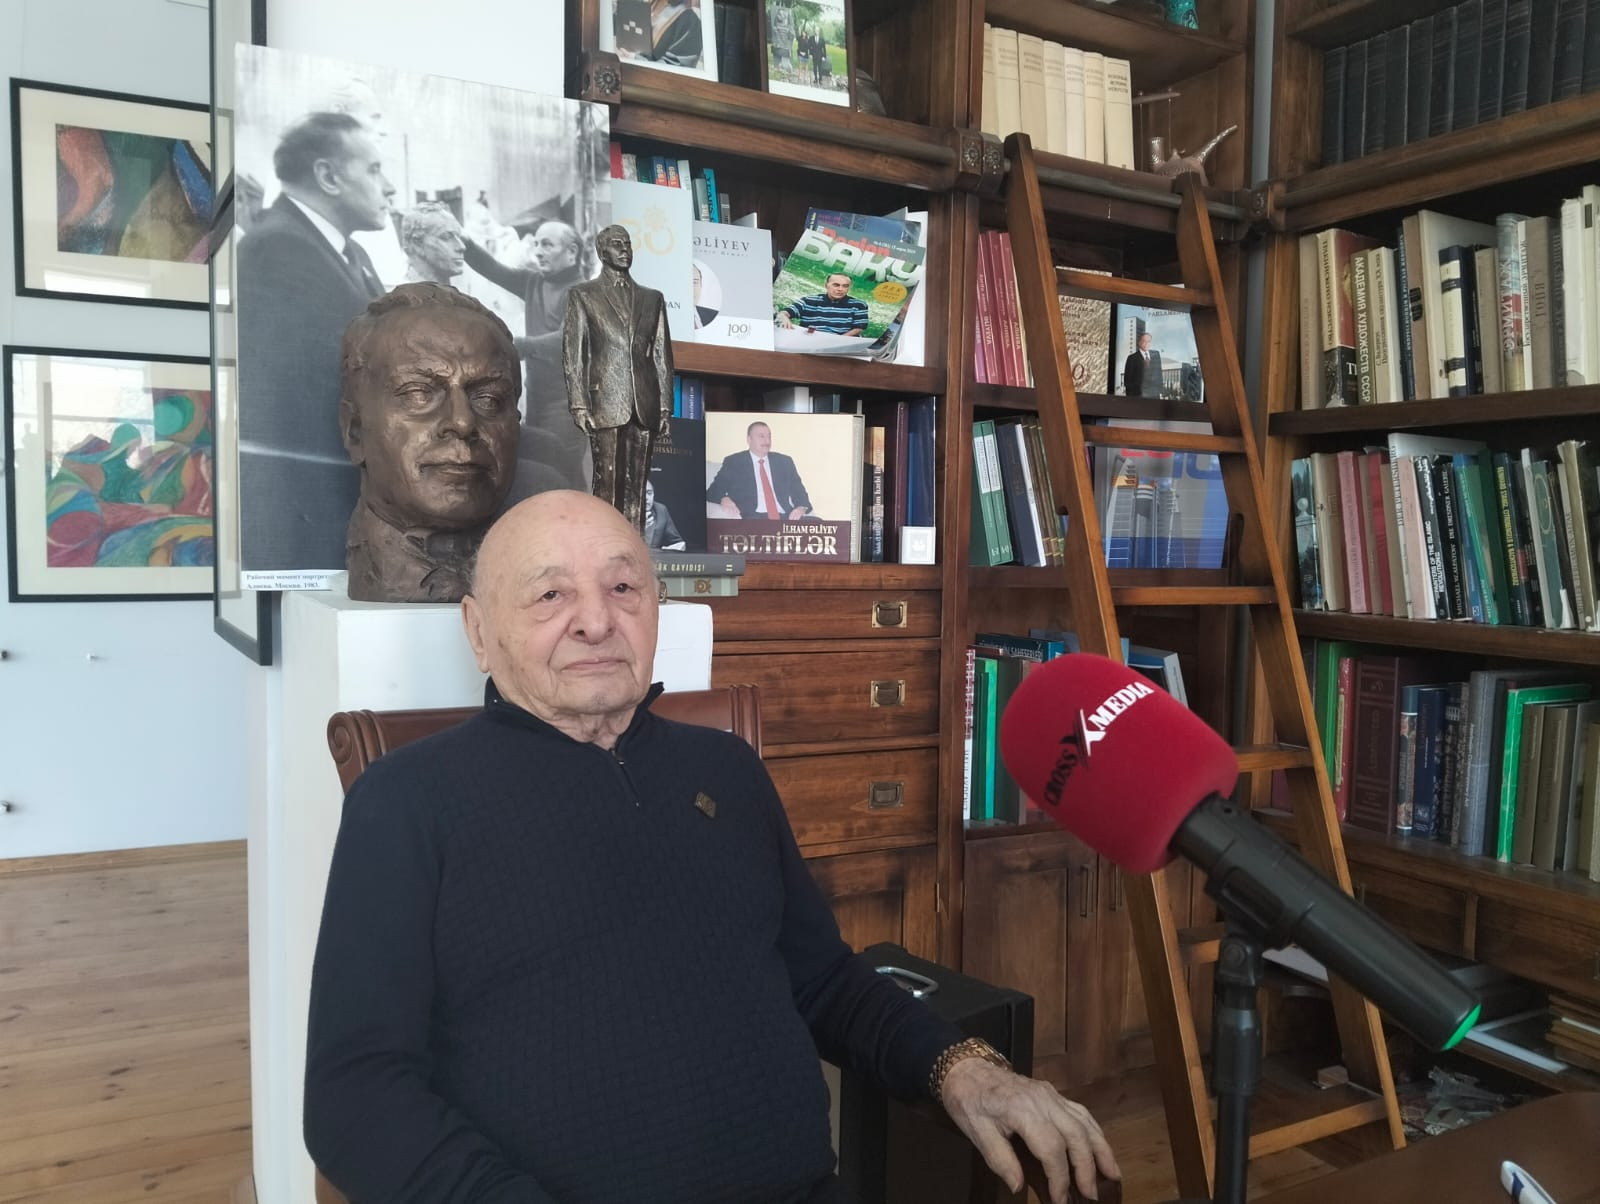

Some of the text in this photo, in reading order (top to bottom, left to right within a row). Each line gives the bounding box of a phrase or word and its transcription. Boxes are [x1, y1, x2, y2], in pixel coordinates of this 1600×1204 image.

[1499, 258, 1515, 351] ЭРМИТАЖ
[727, 323, 748, 337] 100
[1354, 256, 1371, 402] АКАДЕМИЯ ХУДОЖЕСТВ СССР
[782, 523, 838, 534] İLHAM ƏLİYEV
[719, 531, 839, 555] TƏLTİFLƏR
[1427, 543, 1435, 556] THE
[1044, 749, 1078, 807] CROSS
[1088, 681, 1155, 731] MEDIA
